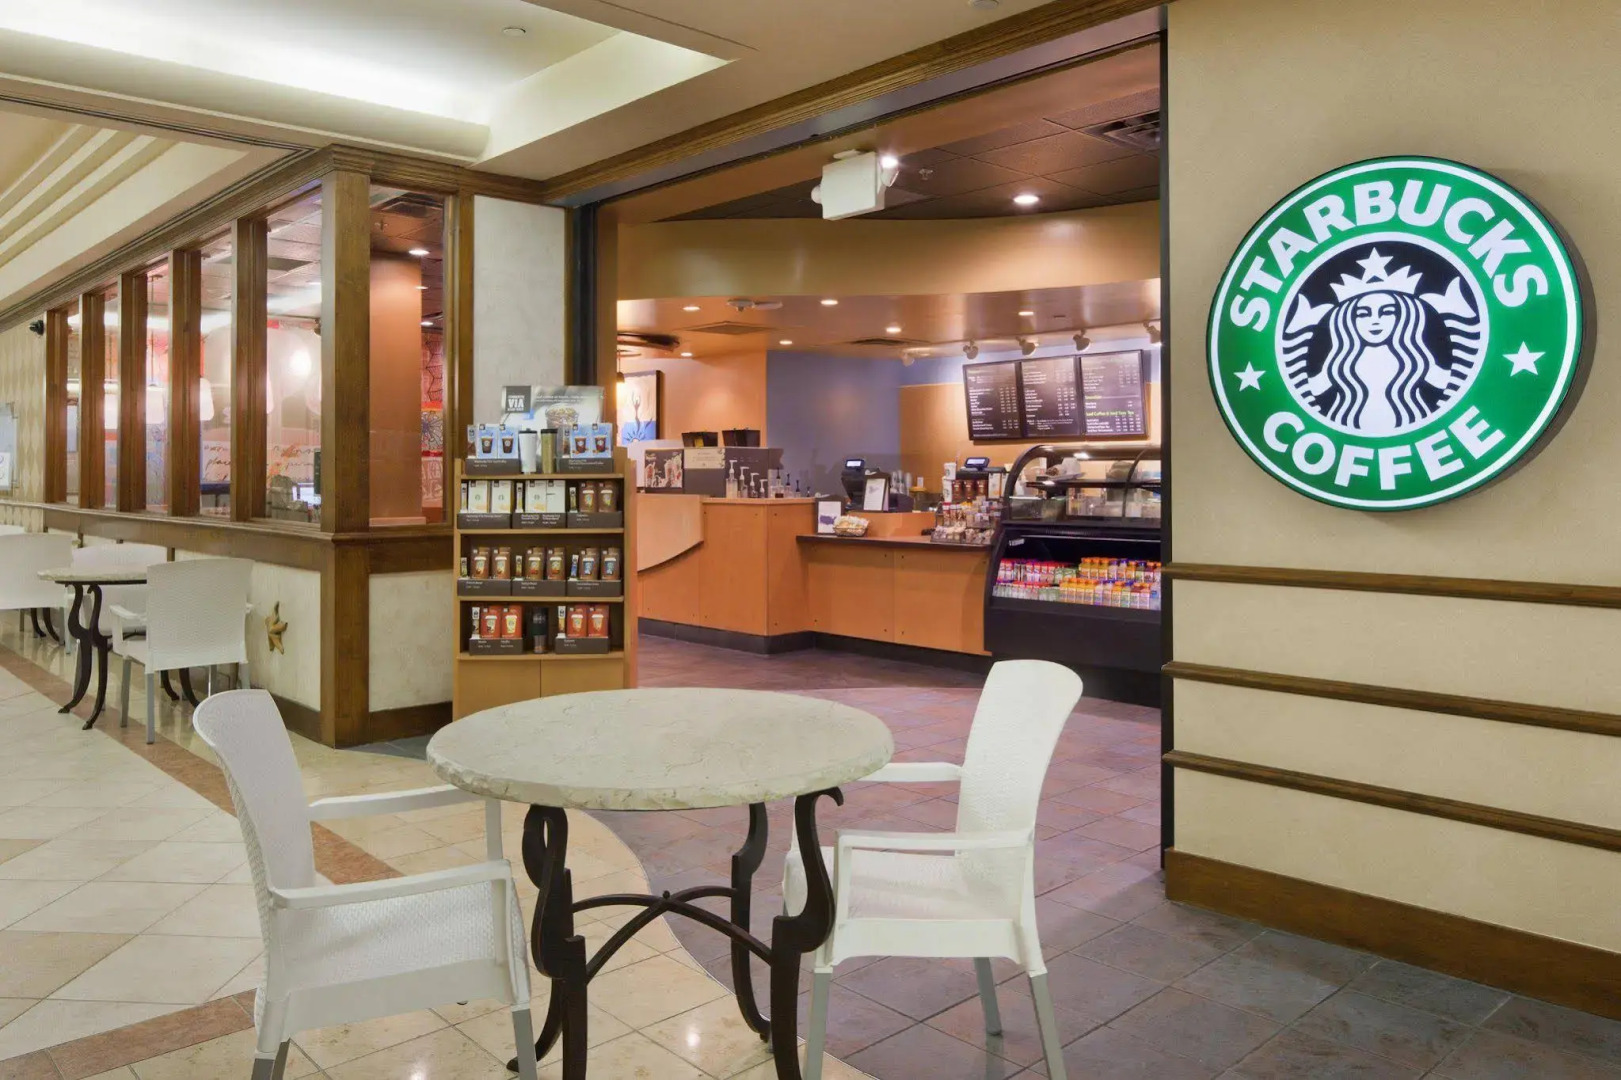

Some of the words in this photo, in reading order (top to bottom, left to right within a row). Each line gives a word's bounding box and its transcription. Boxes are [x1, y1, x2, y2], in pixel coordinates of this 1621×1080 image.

[1230, 179, 1548, 332] STARBUCKS
[508, 398, 524, 408] VIA
[1263, 406, 1506, 490] COFFEE
